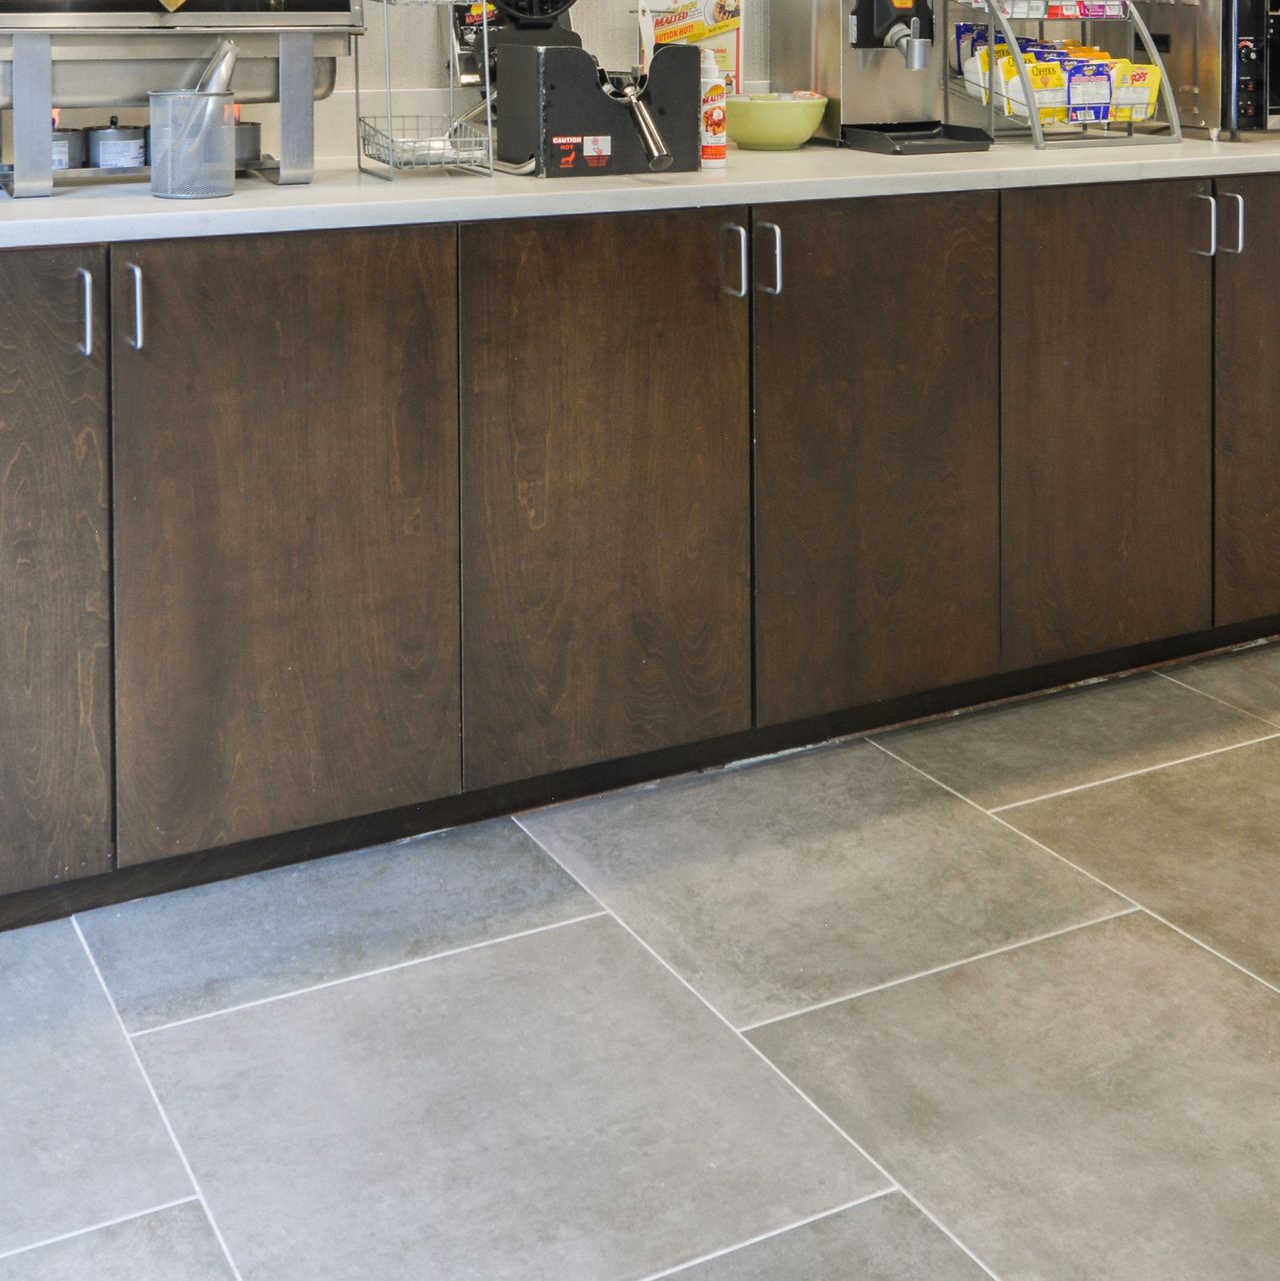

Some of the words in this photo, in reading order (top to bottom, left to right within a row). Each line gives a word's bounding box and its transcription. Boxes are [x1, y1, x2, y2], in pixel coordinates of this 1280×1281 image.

[654, 11, 689, 31] MALTED
[654, 30, 679, 43] AUTION
[679, 25, 694, 35] HOT!
[1031, 65, 1057, 76] Cheerios
